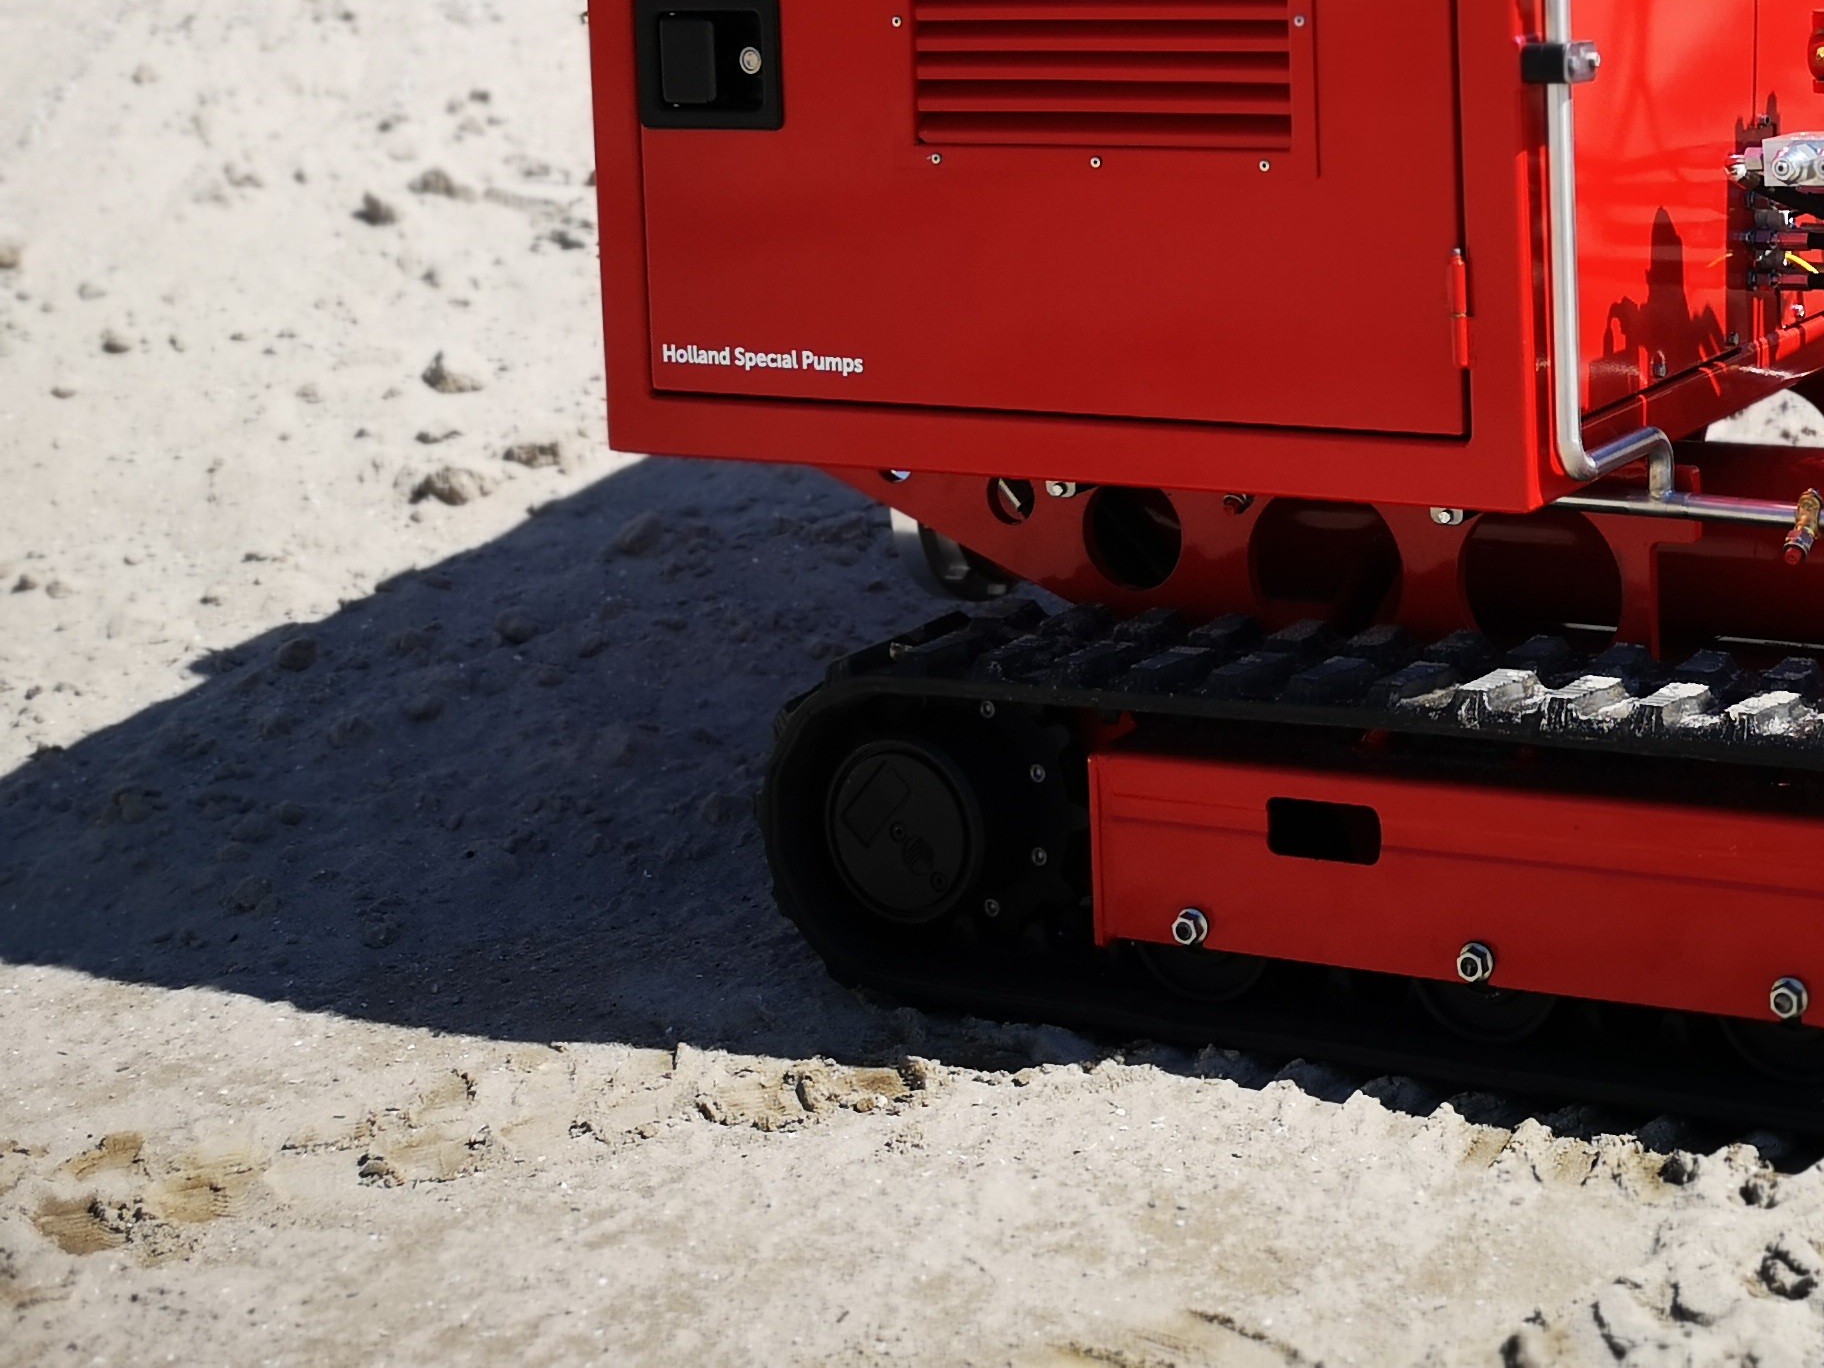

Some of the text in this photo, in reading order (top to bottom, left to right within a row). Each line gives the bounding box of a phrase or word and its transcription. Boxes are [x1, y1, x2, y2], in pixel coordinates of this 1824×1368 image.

[662, 343, 864, 377] Holland Special Pumps
